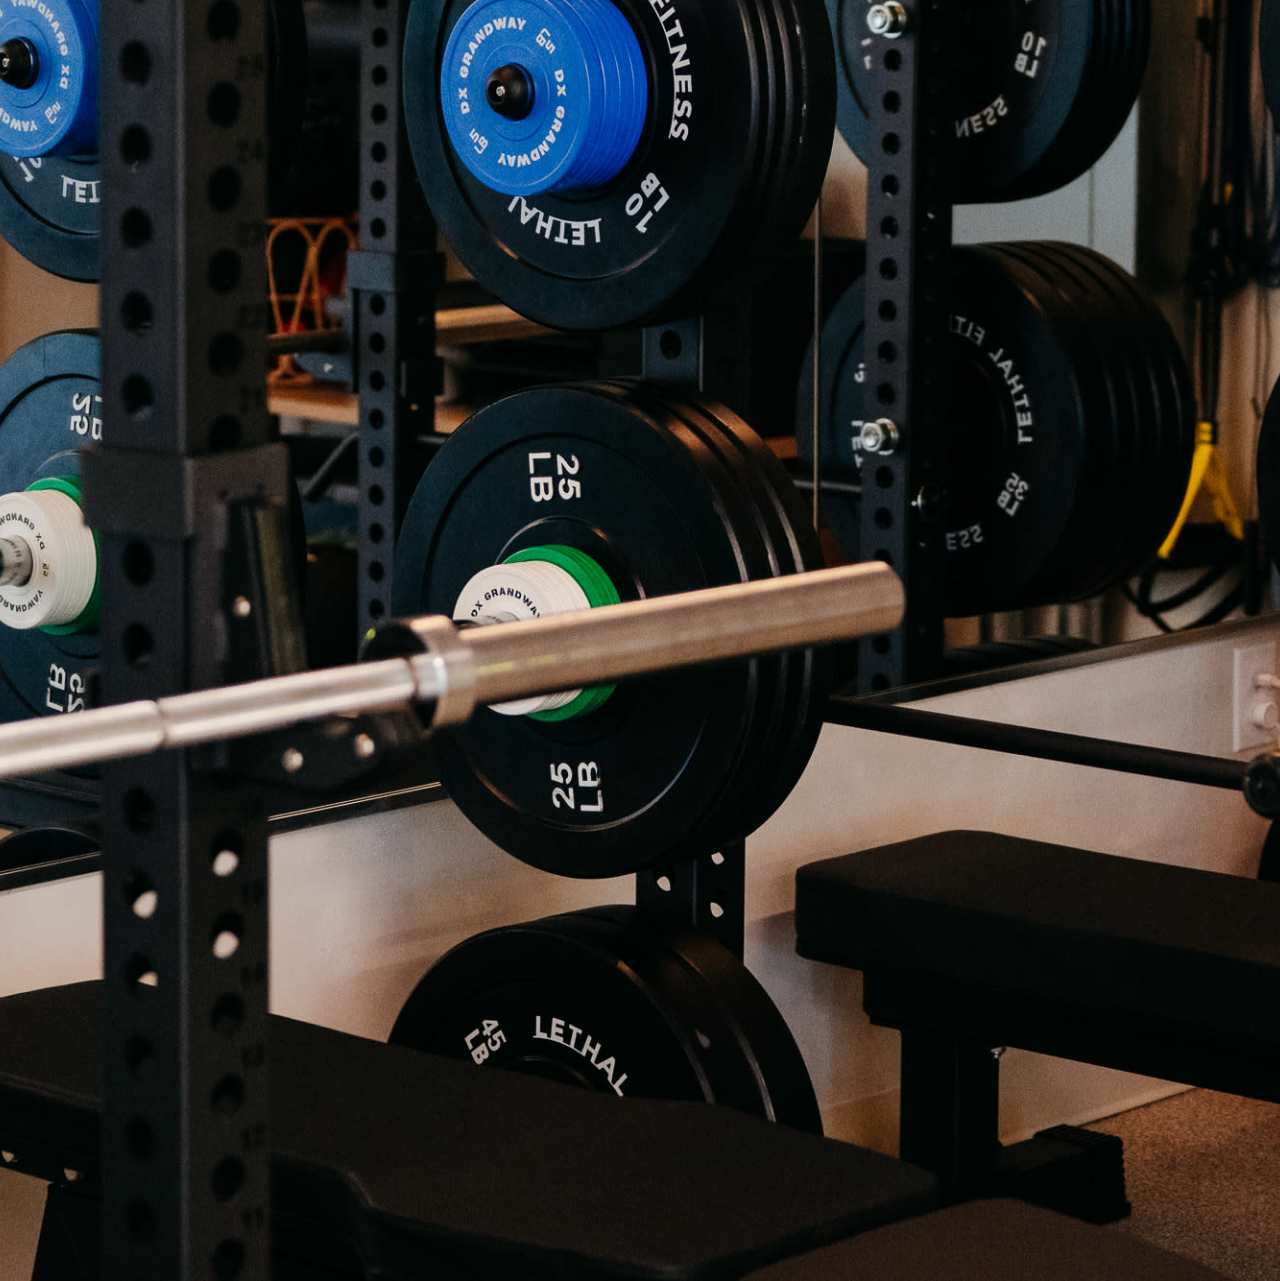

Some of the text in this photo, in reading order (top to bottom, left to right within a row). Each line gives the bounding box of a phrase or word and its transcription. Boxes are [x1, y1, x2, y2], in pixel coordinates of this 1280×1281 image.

[458, 16, 527, 114] DX GRANDWAY
[497, 69, 567, 168] DX GRANDWAY
[625, 192, 654, 234] 10
[640, 172, 671, 213] LB
[528, 452, 554, 503] LB
[556, 453, 583, 502] 25
[550, 760, 576, 810] 25
[578, 760, 605, 814] LB
[463, 1028, 490, 1066] LB
[481, 1018, 507, 1053] 45
[532, 1015, 629, 1097] LETHAL
